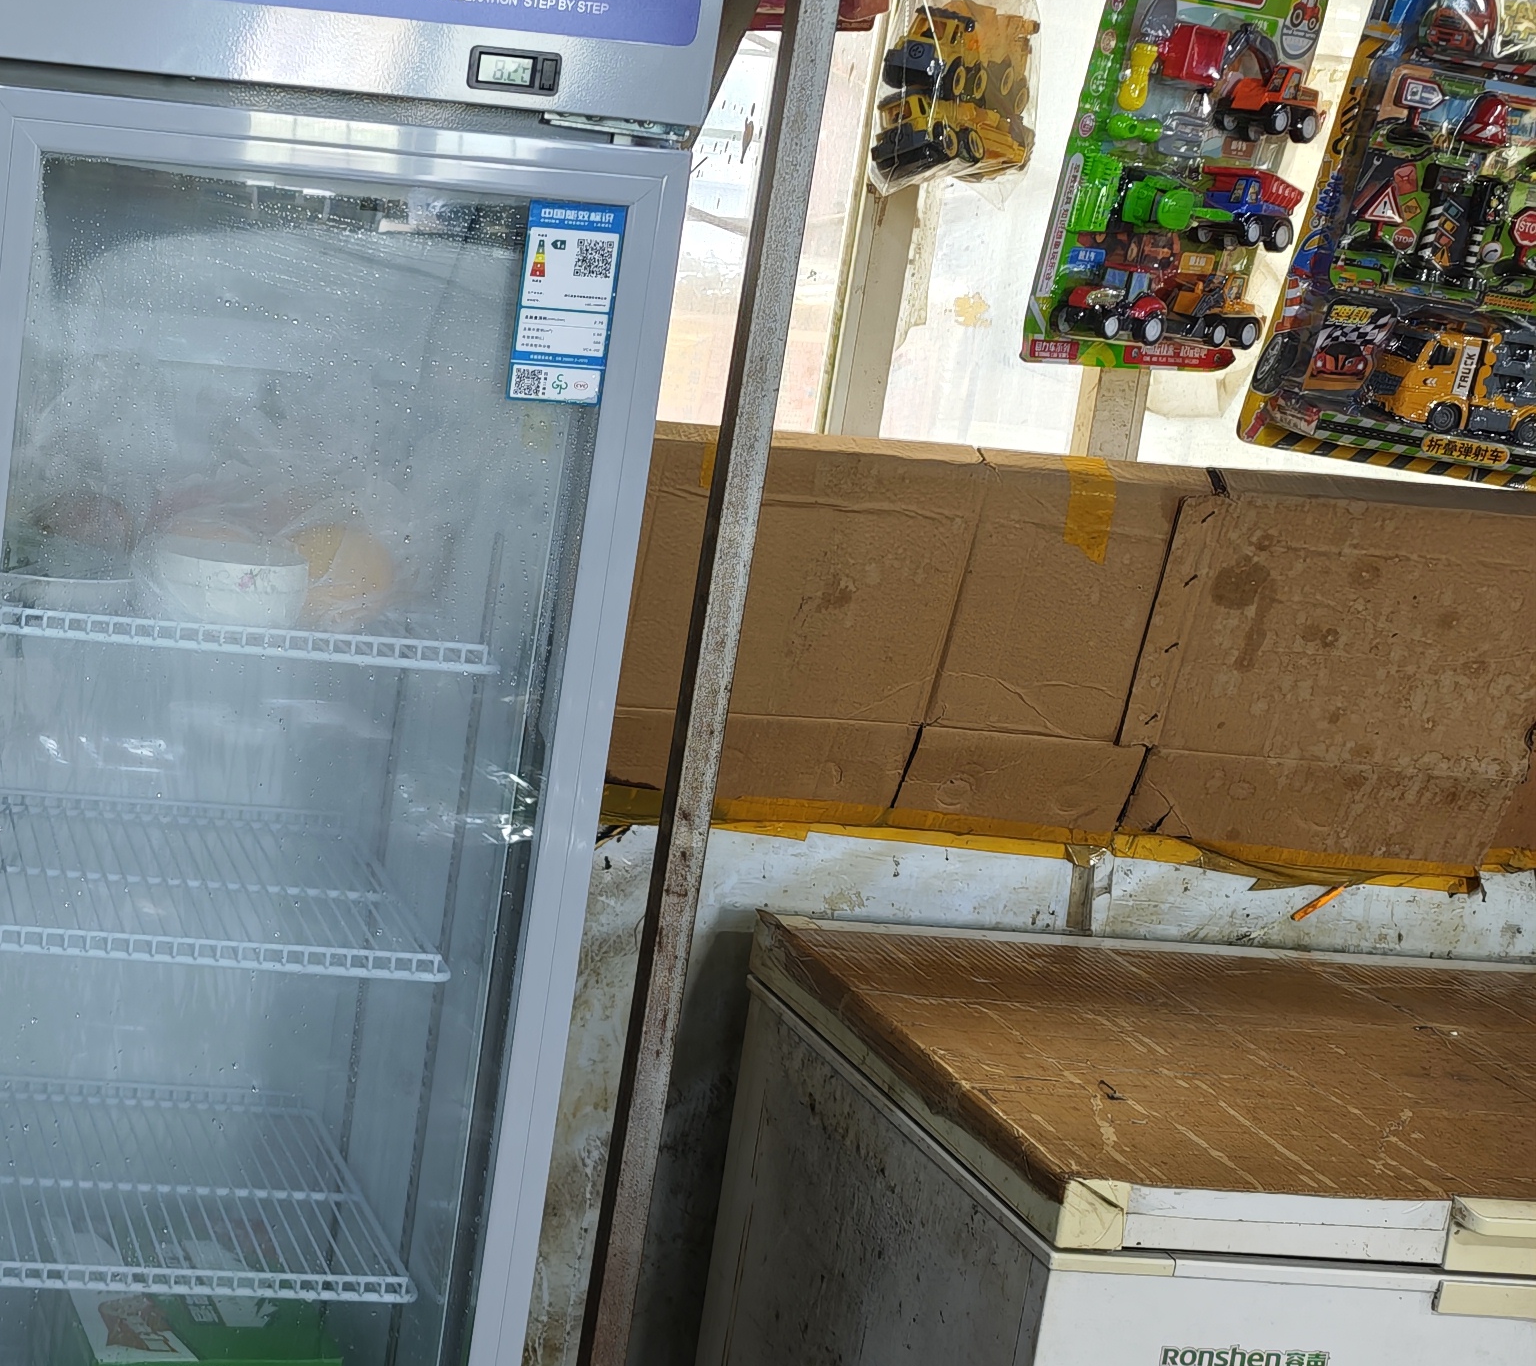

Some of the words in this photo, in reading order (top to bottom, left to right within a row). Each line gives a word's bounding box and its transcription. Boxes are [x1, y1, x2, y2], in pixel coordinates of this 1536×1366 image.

[577, 0, 610, 15] STEP
[541, 208, 614, 223] 中国能效标识
[1394, 234, 1413, 244] STOP
[1456, 351, 1477, 391] TRUCK
[1425, 437, 1504, 464] 折叠弹射车
